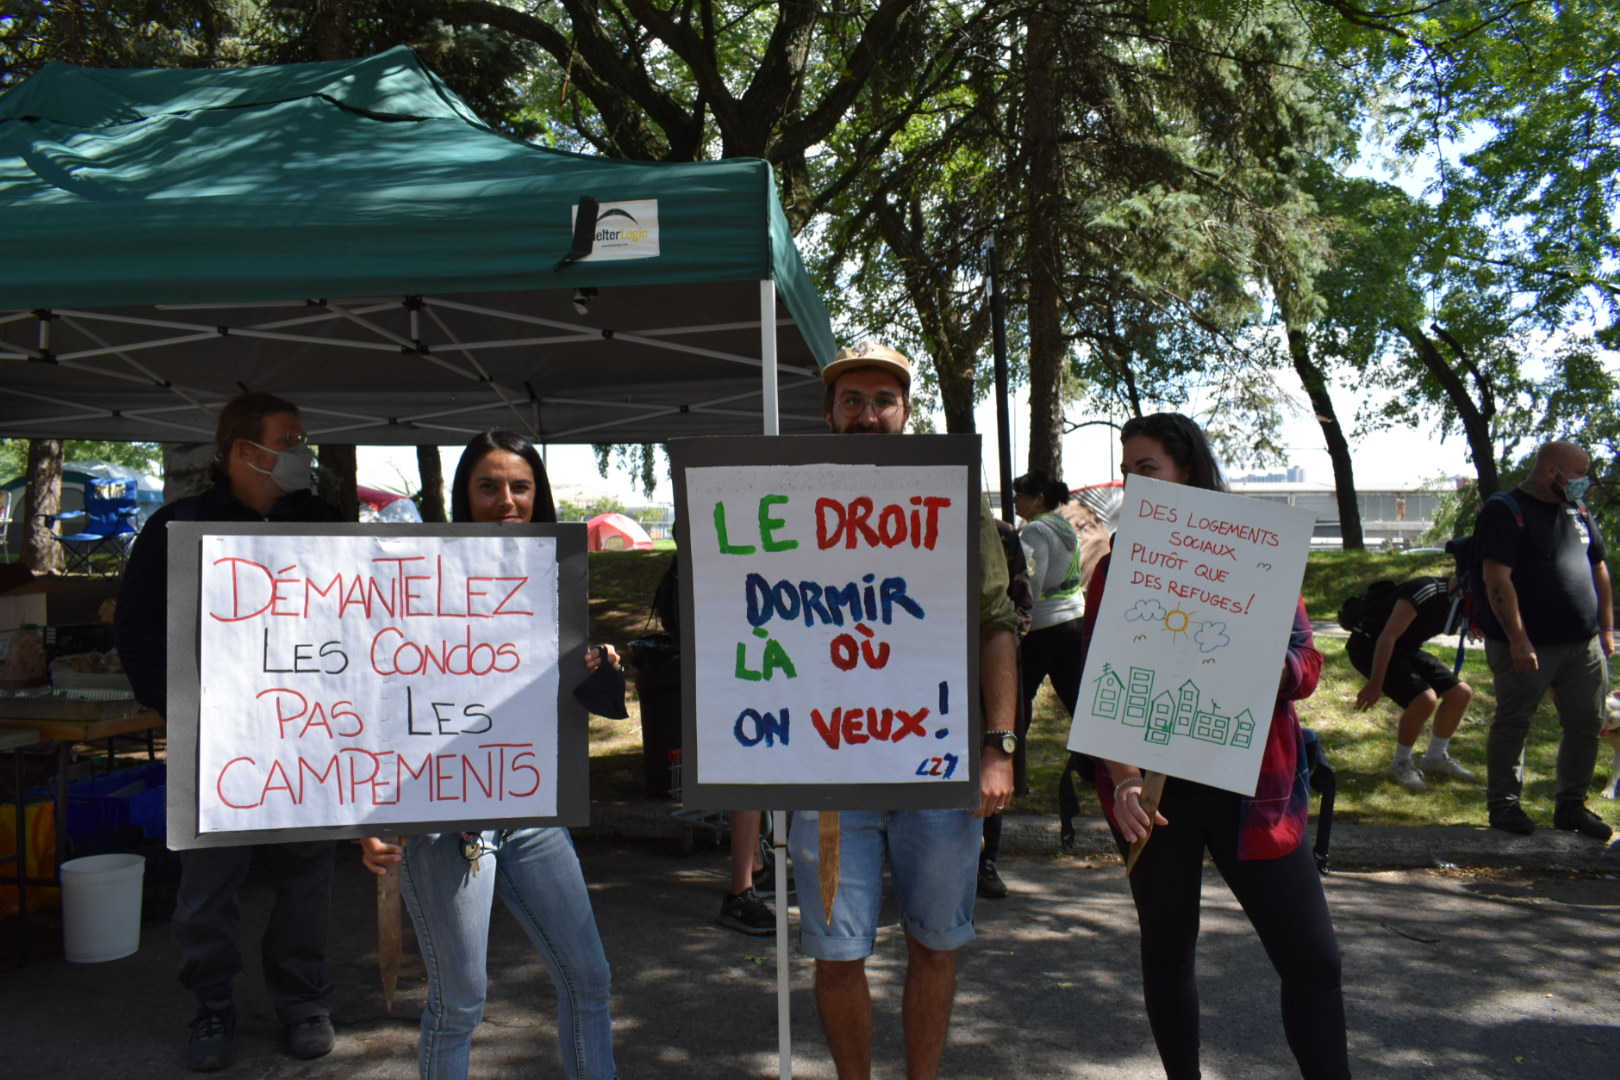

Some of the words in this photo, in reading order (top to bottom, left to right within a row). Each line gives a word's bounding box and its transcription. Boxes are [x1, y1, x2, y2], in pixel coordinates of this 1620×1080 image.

[713, 494, 799, 555] LE
[1138, 499, 1178, 523] DES
[1186, 512, 1280, 547] LOGEMENTS
[1168, 531, 1237, 561] SOCIAUX
[1130, 542, 1189, 570] PLUTÔT
[1194, 564, 1230, 583] QUE
[1130, 570, 1162, 590] DES
[210, 554, 534, 622] DÉMANTELEZ
[263, 627, 349, 674] LES
[735, 625, 798, 681] LÀ
[829, 622, 891, 671] OÙ
[256, 688, 364, 739] PAS
[407, 686, 493, 736] LES
[733, 707, 790, 748] ON
[217, 743, 541, 809] CAMPEMENTS
